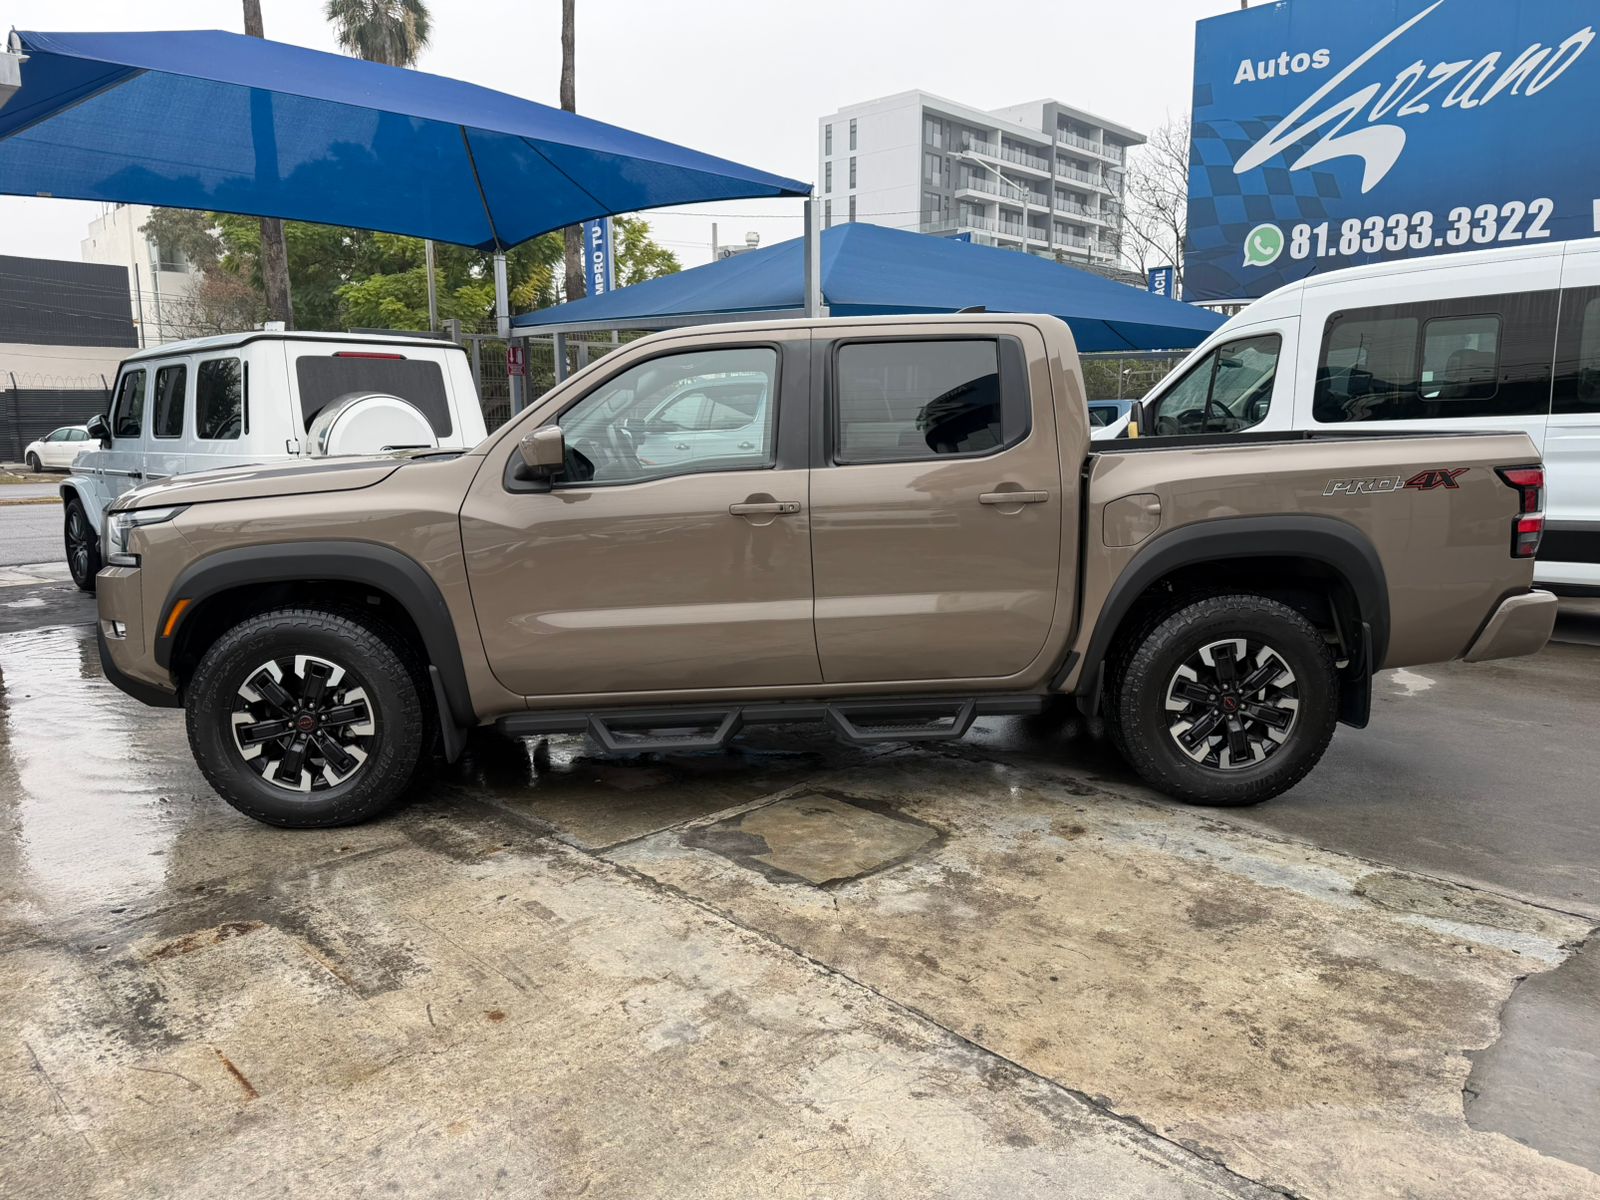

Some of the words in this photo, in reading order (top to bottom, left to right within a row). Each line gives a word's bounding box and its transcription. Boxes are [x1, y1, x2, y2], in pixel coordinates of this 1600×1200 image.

[1233, 48, 1331, 85] Autos
[592, 226, 603, 248] TU
[1289, 197, 1555, 260] 81.8333.3322
